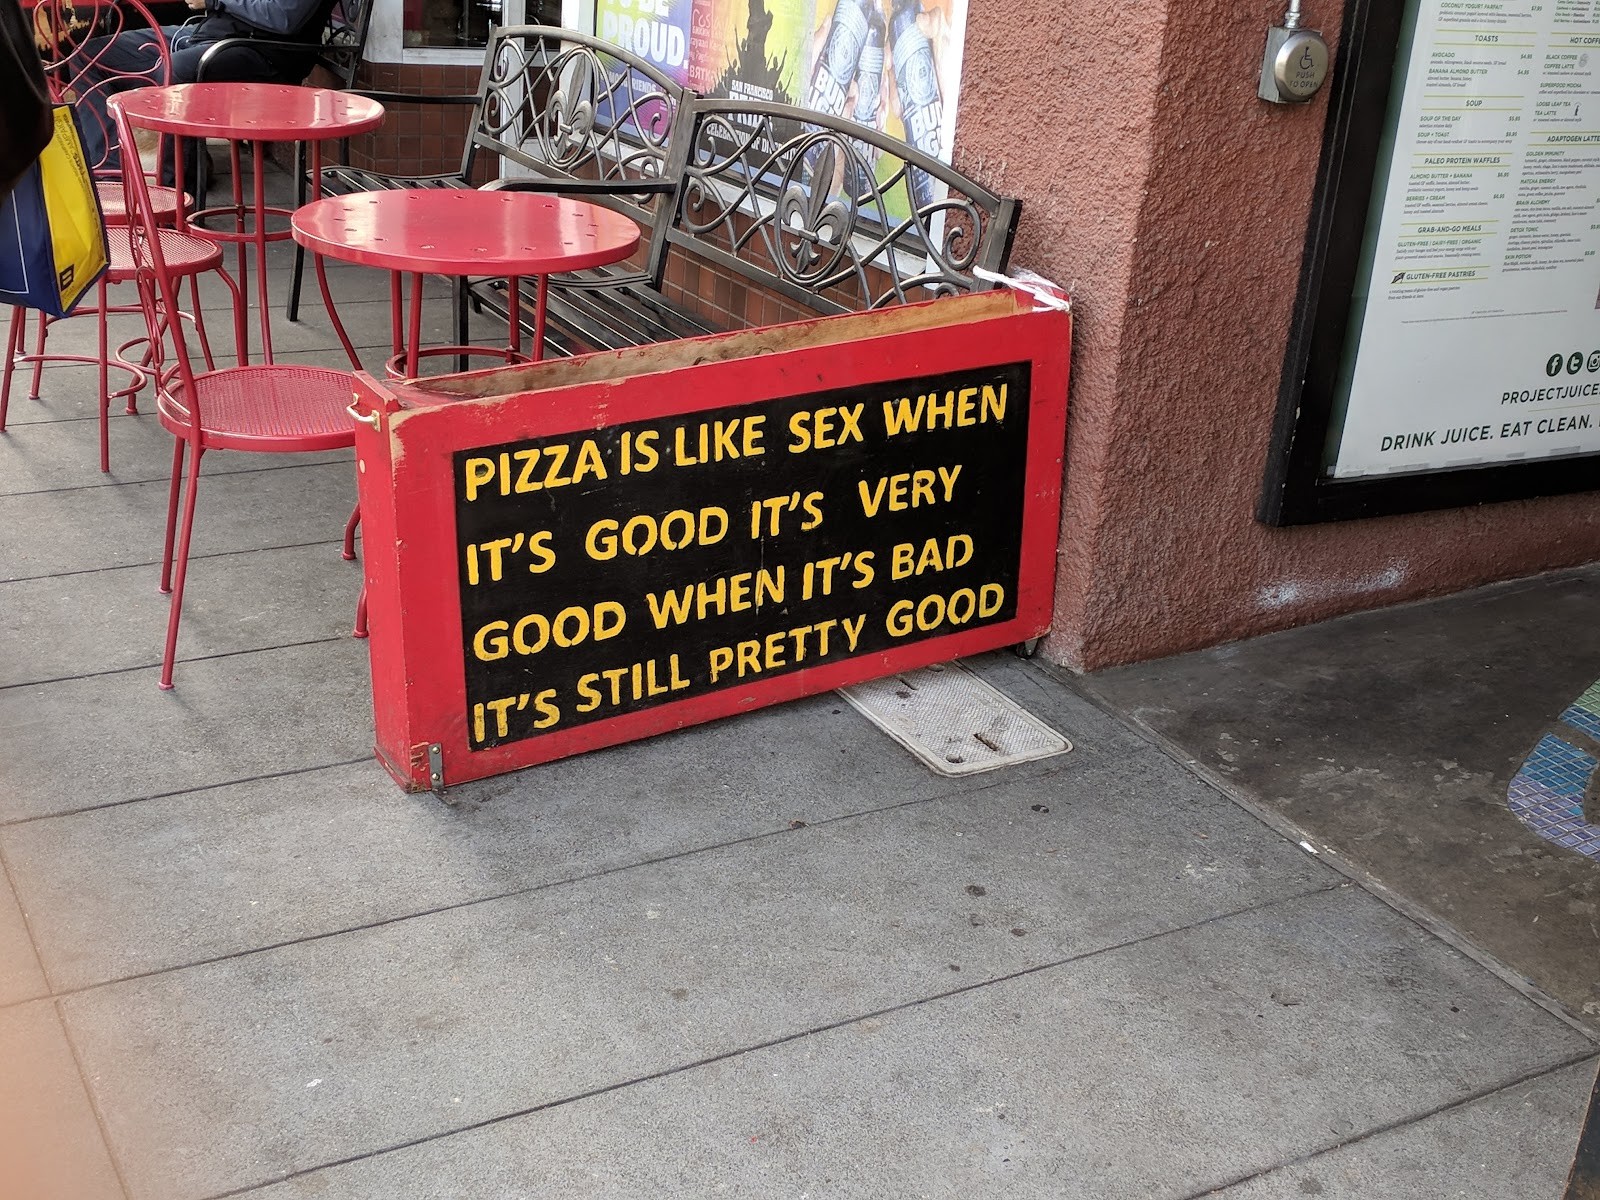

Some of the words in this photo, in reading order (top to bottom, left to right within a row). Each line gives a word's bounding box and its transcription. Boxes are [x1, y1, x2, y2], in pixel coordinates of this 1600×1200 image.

[603, 10, 689, 70] PROUD.
[732, 80, 744, 92] SAN
[743, 82, 774, 101] FRANCISCO
[1295, 71, 1316, 79] PUSH
[1406, 272, 1447, 280] GLUTEN-FREE
[1447, 270, 1476, 278] PASTRIES
[465, 439, 608, 501] PIZZA
[620, 430, 660, 475] IS
[675, 414, 766, 467] LIKE
[788, 403, 865, 454] SEX
[883, 383, 1008, 437] WHEN
[1380, 430, 1437, 452] DRINK
[1440, 425, 1494, 445] JUICE.
[1500, 421, 1533, 439] EAT
[1536, 414, 1593, 434] CLEAN.
[466, 530, 556, 586] IT'S
[585, 506, 729, 561] GOOD
[751, 491, 824, 540] IT'S
[858, 464, 963, 518] VERY
[473, 601, 627, 662] GOOD
[646, 564, 785, 630] WHEN
[802, 551, 875, 601] IT'S
[891, 533, 974, 581] BAD
[473, 688, 561, 743] IT'S
[576, 653, 691, 713] STILL
[709, 613, 867, 684] PRETTY
[886, 582, 1005, 637] GOOD
